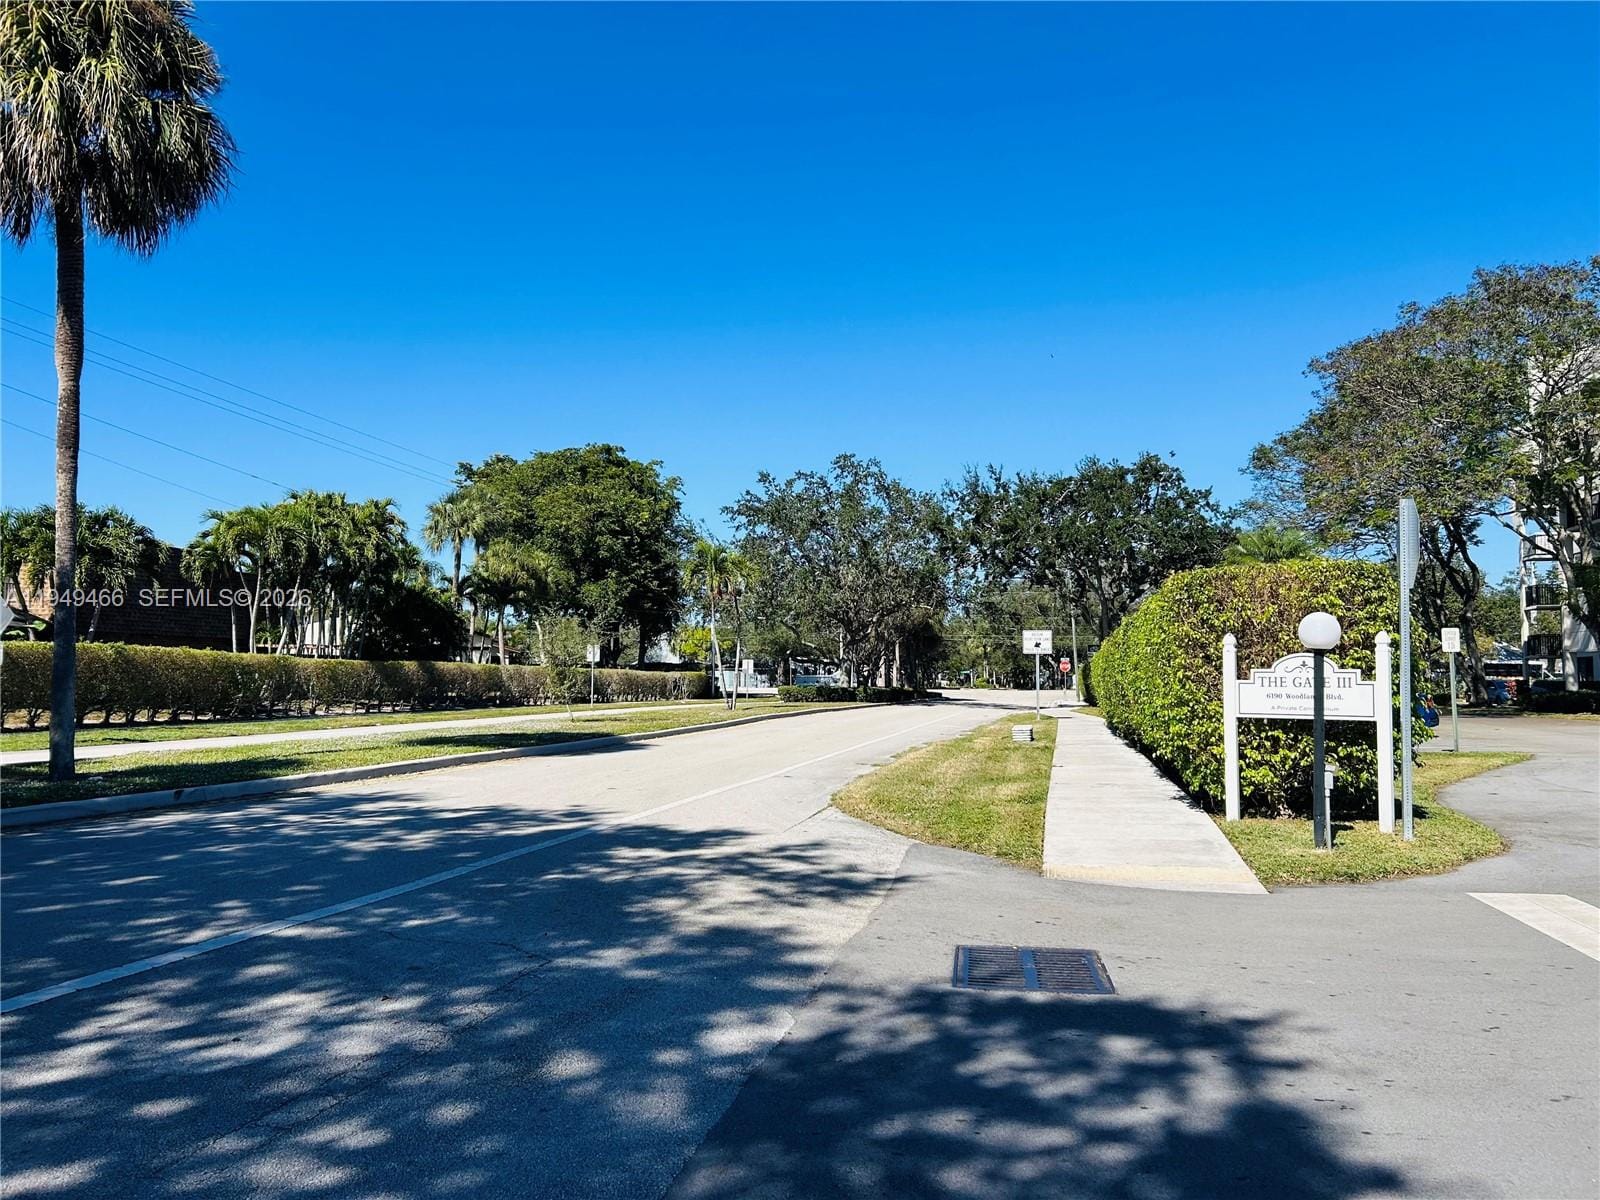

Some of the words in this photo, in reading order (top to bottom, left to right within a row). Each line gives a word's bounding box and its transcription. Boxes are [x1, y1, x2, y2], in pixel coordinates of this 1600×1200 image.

[1258, 676, 1287, 688] THE
[1292, 676, 1331, 688] GAE
[1337, 677, 1353, 688] III
